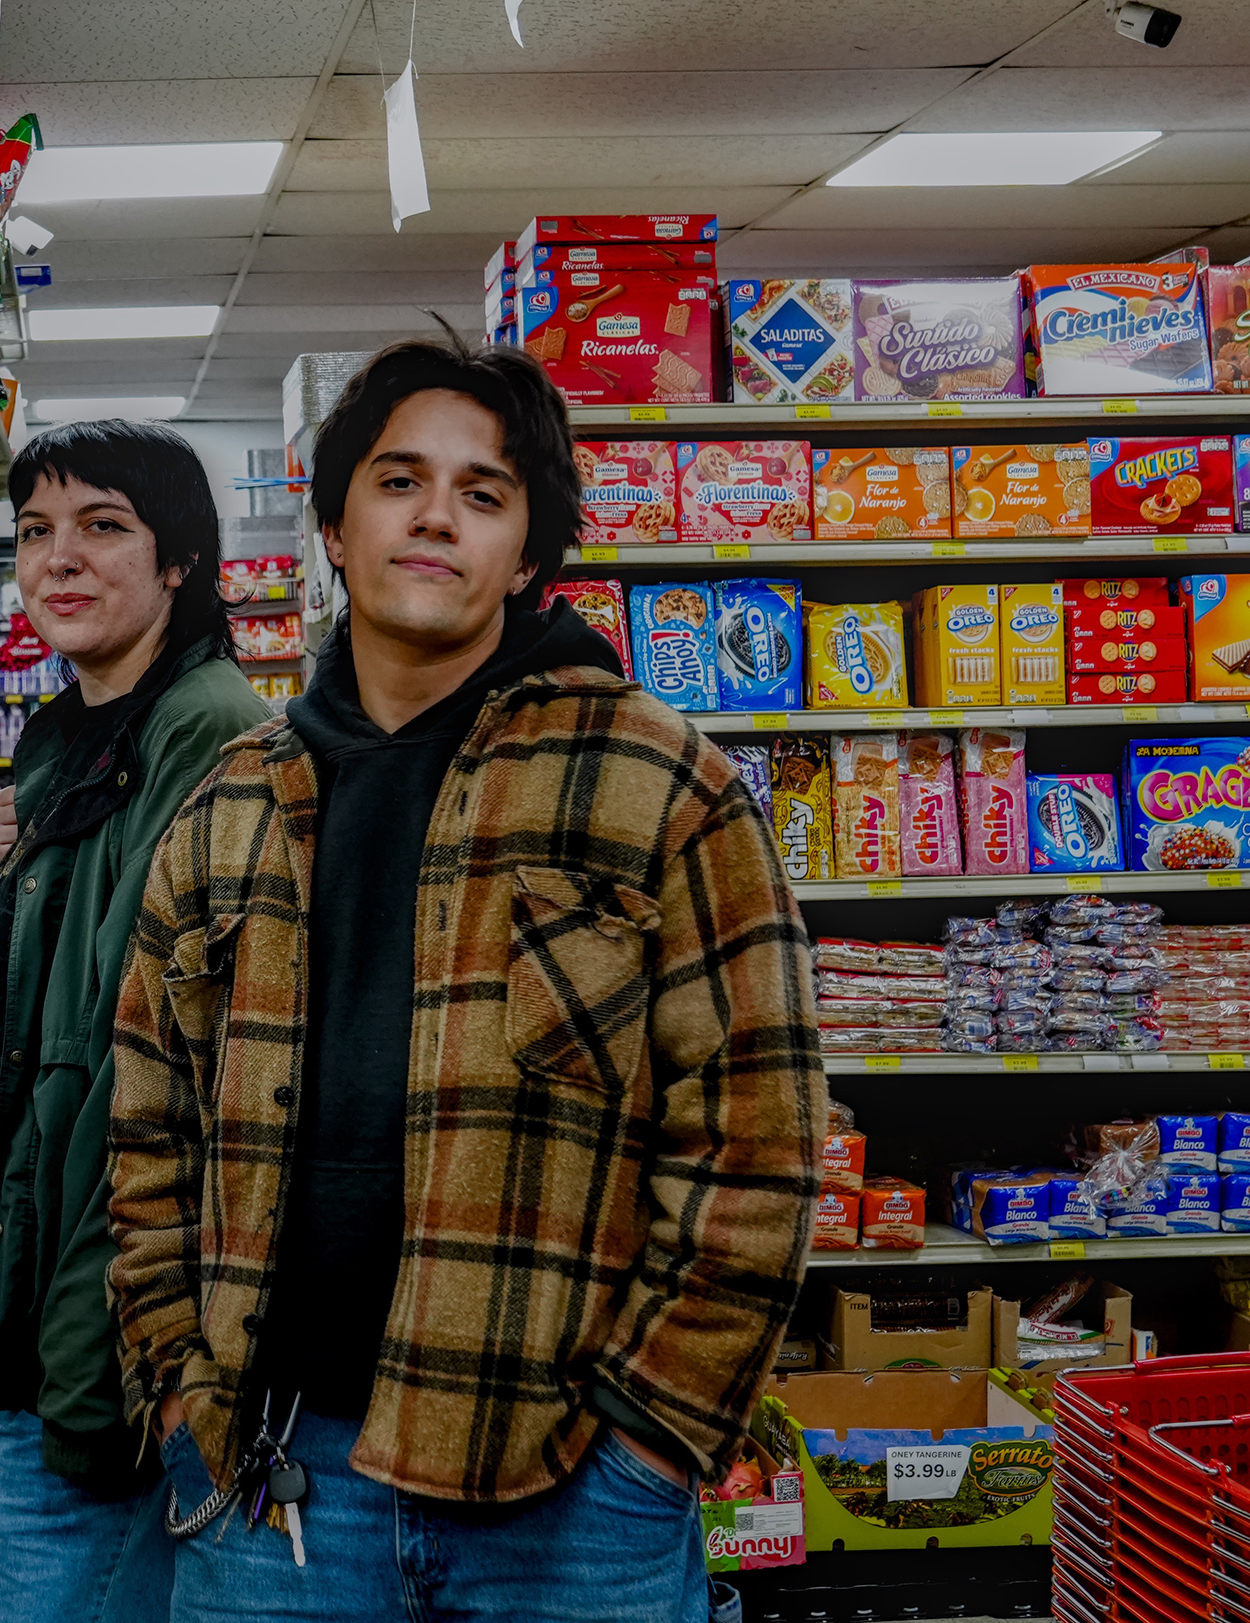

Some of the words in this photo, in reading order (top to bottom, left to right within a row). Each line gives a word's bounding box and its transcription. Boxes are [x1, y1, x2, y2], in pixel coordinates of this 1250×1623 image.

[562, 260, 604, 271] Ricanelas
[1072, 275, 1090, 288] EL
[1090, 273, 1156, 288] MEXICANO
[598, 320, 639, 331] Gamesa
[1047, 297, 1127, 339] Cremi
[1108, 307, 1194, 343] nieves
[760, 328, 825, 344] SALADITAS
[881, 317, 979, 355] Surtido
[1130, 338, 1158, 351] Sugar
[1160, 327, 1198, 344] Wafers
[900, 345, 996, 379] Clásico
[729, 465, 760, 473] Gamesa
[866, 468, 897, 477] Gamesa
[1007, 466, 1038, 475] Gamesa
[1116, 447, 1195, 487] CRACKETS
[702, 483, 787, 505] Florentinas
[866, 484, 888, 496] Flor
[1006, 482, 1029, 494] Flor
[860, 496, 907, 511] Naranjo
[1000, 494, 1047, 509] Naranjo
[988, 588, 995, 596] 4
[1052, 588, 1060, 596] 4
[1101, 582, 1122, 595] RITZ
[955, 607, 984, 615] GOLDEN
[1019, 607, 1048, 615] GOLDEN
[1117, 611, 1137, 625] RITZ
[947, 613, 994, 632] OREO
[1011, 612, 1059, 632] OREO
[744, 606, 770, 683] OREO
[1118, 644, 1139, 657] RITZ
[838, 635, 848, 673] GOLDEN
[843, 616, 875, 694] OREO
[653, 641, 684, 690] Chips
[1116, 676, 1137, 690] RITZ
[1049, 793, 1057, 814] STUF
[1057, 784, 1086, 858] OREO
[1051, 814, 1064, 848] DOUBLE
[1173, 1140, 1205, 1149] Blanco
[1178, 1199, 1210, 1209] Blanco
[878, 1210, 913, 1222] Integral
[1005, 1210, 1037, 1220] Blanco
[849, 1302, 869, 1311] ITEM
[915, 1451, 962, 1459] TANGERINE
[972, 1446, 1052, 1472] Serrato
[893, 1463, 944, 1480] $3.99
[981, 1471, 1045, 1488] Farms
[987, 1494, 1010, 1502] EXOTIC
[1012, 1493, 1036, 1502] FRUITS
